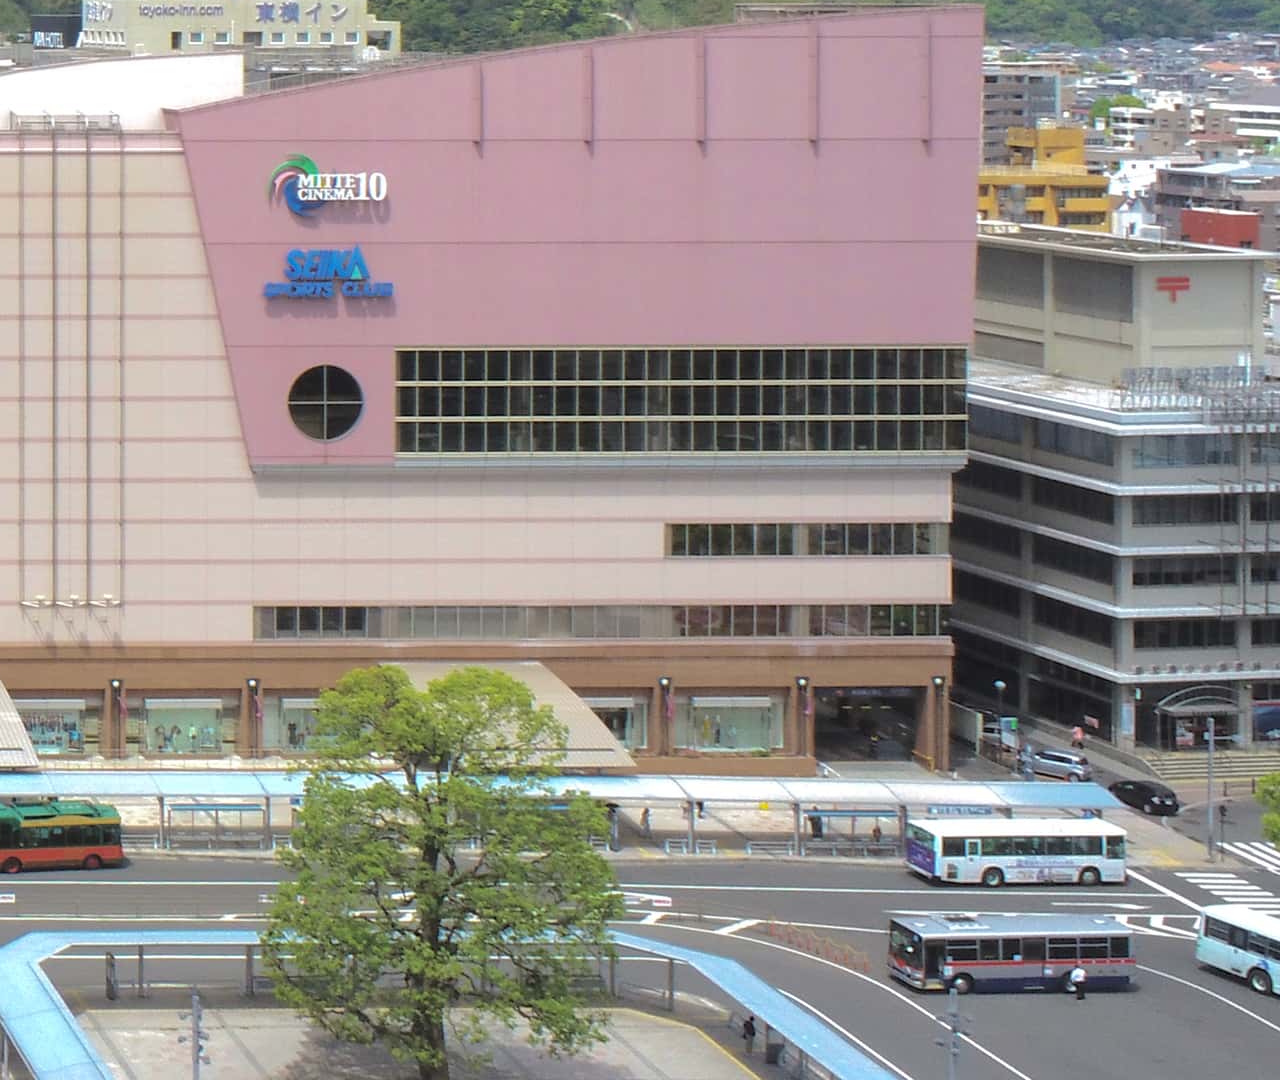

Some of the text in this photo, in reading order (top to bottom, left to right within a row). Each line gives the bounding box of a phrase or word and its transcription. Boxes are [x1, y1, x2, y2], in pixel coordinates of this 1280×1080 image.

[139, 4, 225, 19] toyoko-inn.com
[255, 1, 349, 25] 東横イン
[296, 173, 356, 188] MITTE
[296, 171, 388, 201] CINEMA 10
[284, 243, 370, 280] SEIKA
